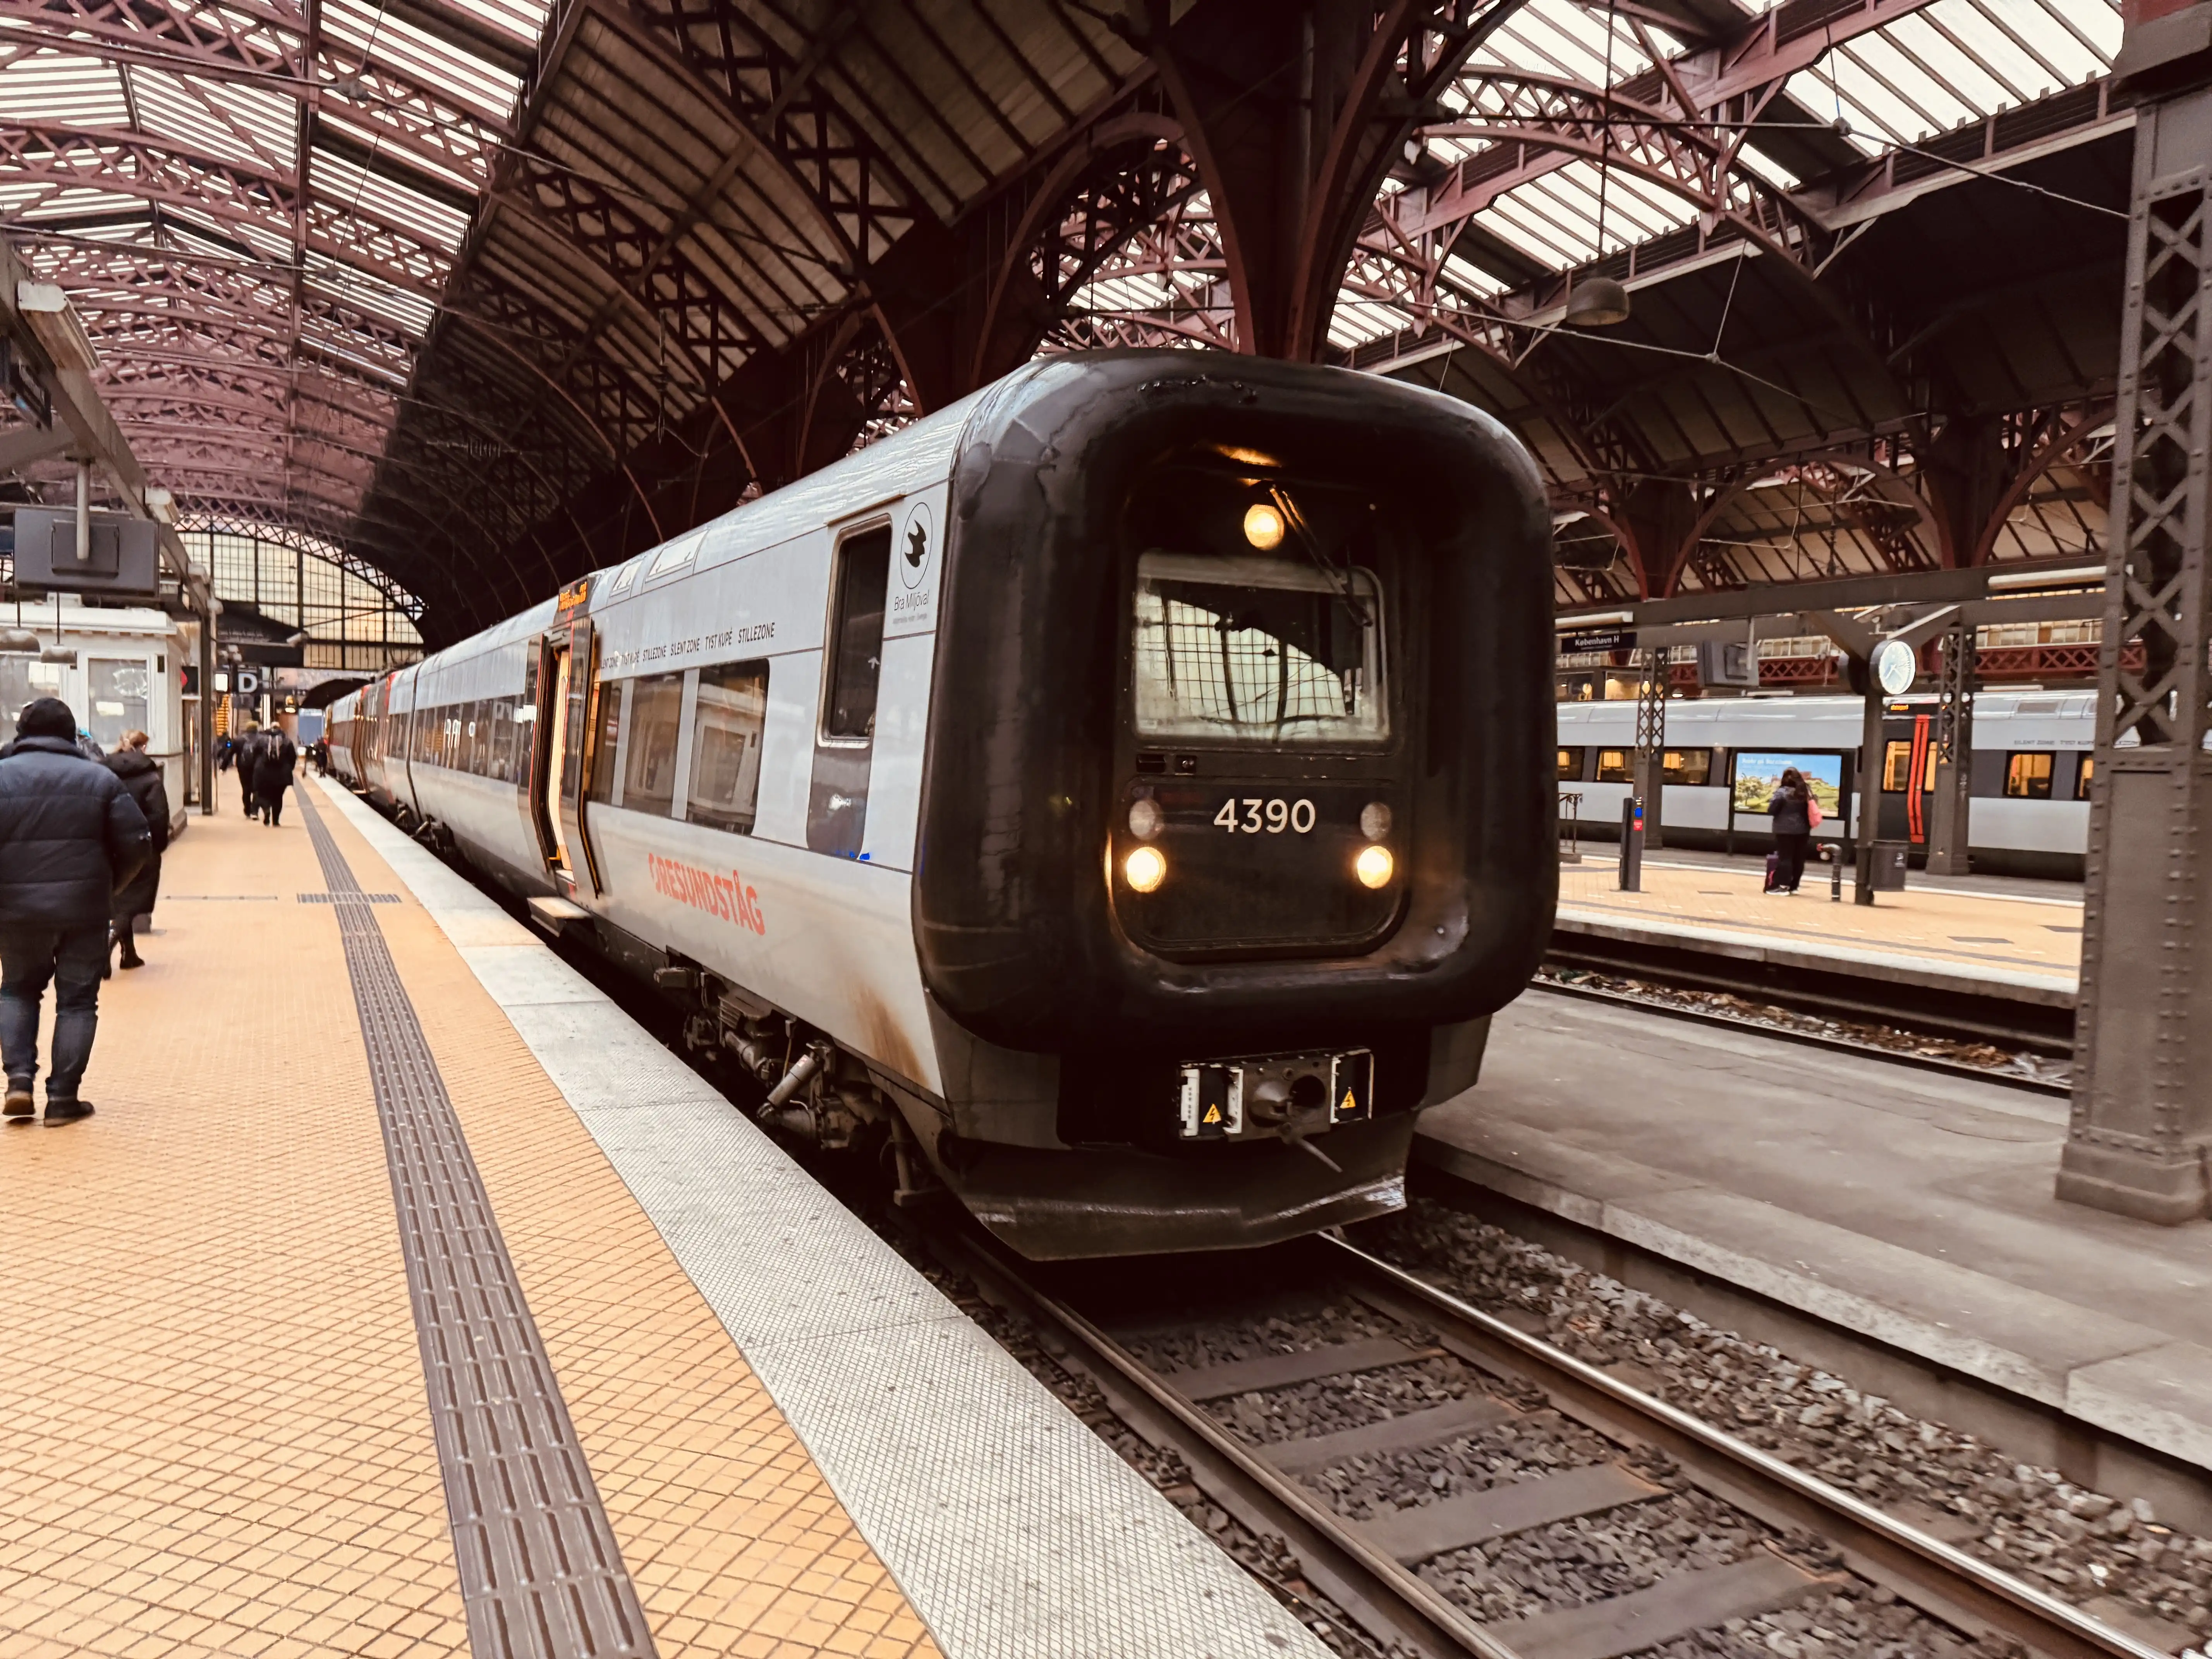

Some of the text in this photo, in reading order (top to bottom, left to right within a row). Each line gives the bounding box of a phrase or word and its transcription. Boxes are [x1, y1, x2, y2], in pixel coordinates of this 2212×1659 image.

[894, 596, 905, 611] Bra
[643, 645, 666, 662] STILLEZONE
[671, 641, 686, 656] SILENT
[687, 637, 700, 653] ZONE
[705, 634, 718, 651] TYST
[718, 627, 733, 648] KUPÉ
[738, 622, 775, 644] STILLEZONE
[1575, 637, 1612, 646] København
[238, 673, 258, 692] D
[1213, 798, 1316, 834] 4390
